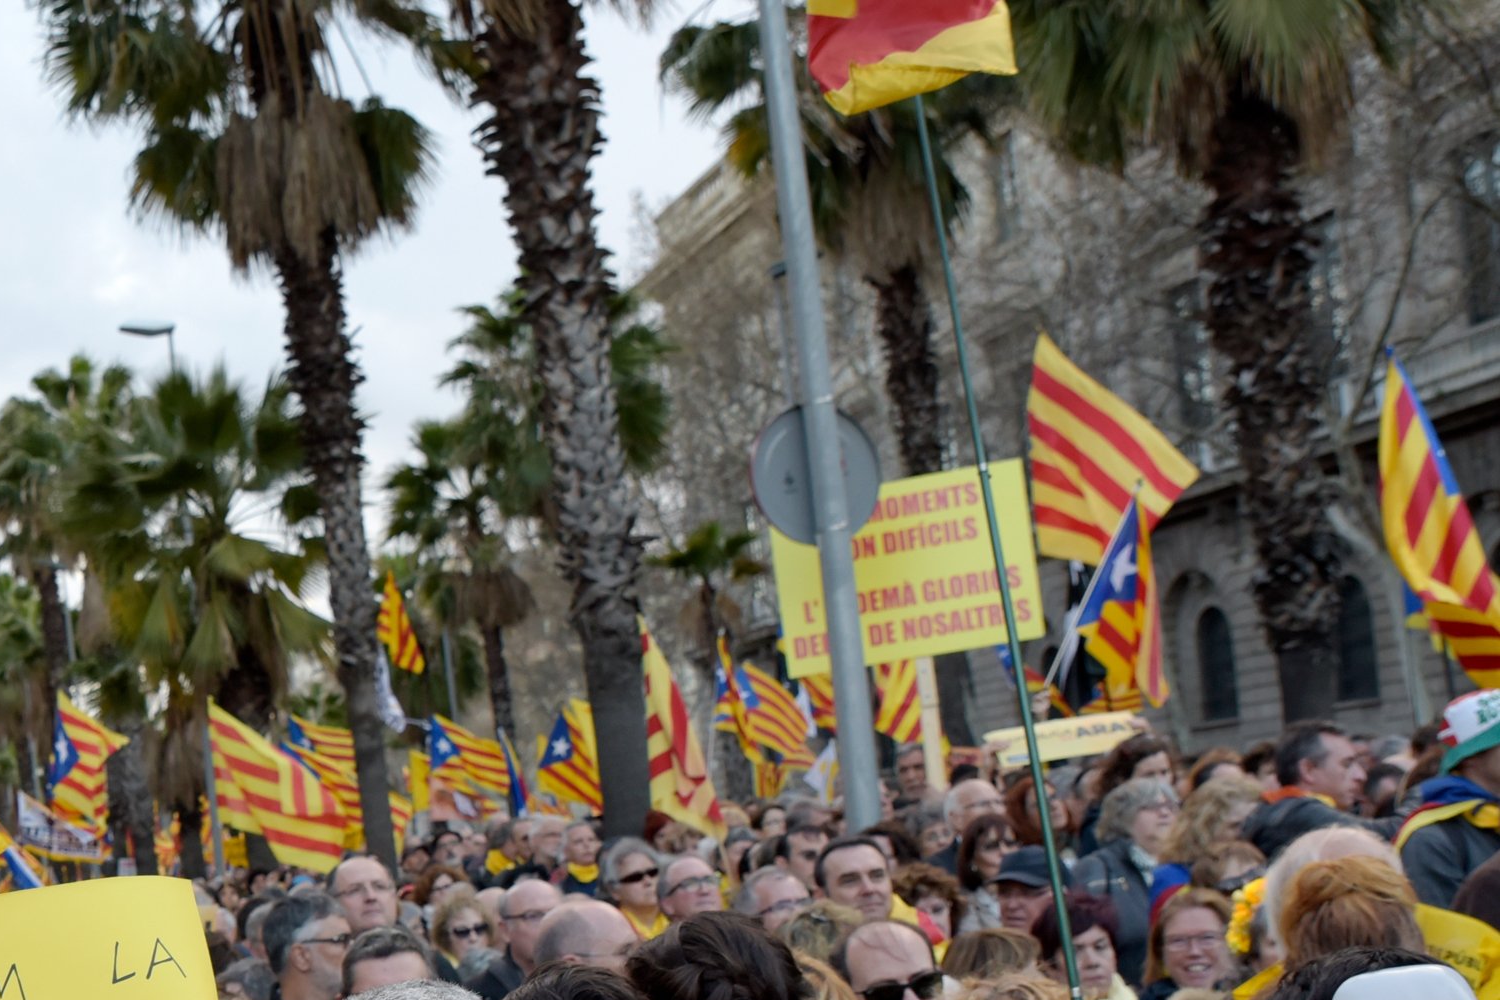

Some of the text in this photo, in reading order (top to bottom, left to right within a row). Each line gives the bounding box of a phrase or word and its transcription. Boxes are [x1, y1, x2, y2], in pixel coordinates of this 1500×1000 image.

[882, 517, 978, 555] DIFÍCILS
[869, 622, 896, 646] DE
[903, 599, 1031, 641] NOSALTRS
[111, 937, 187, 984] LA
